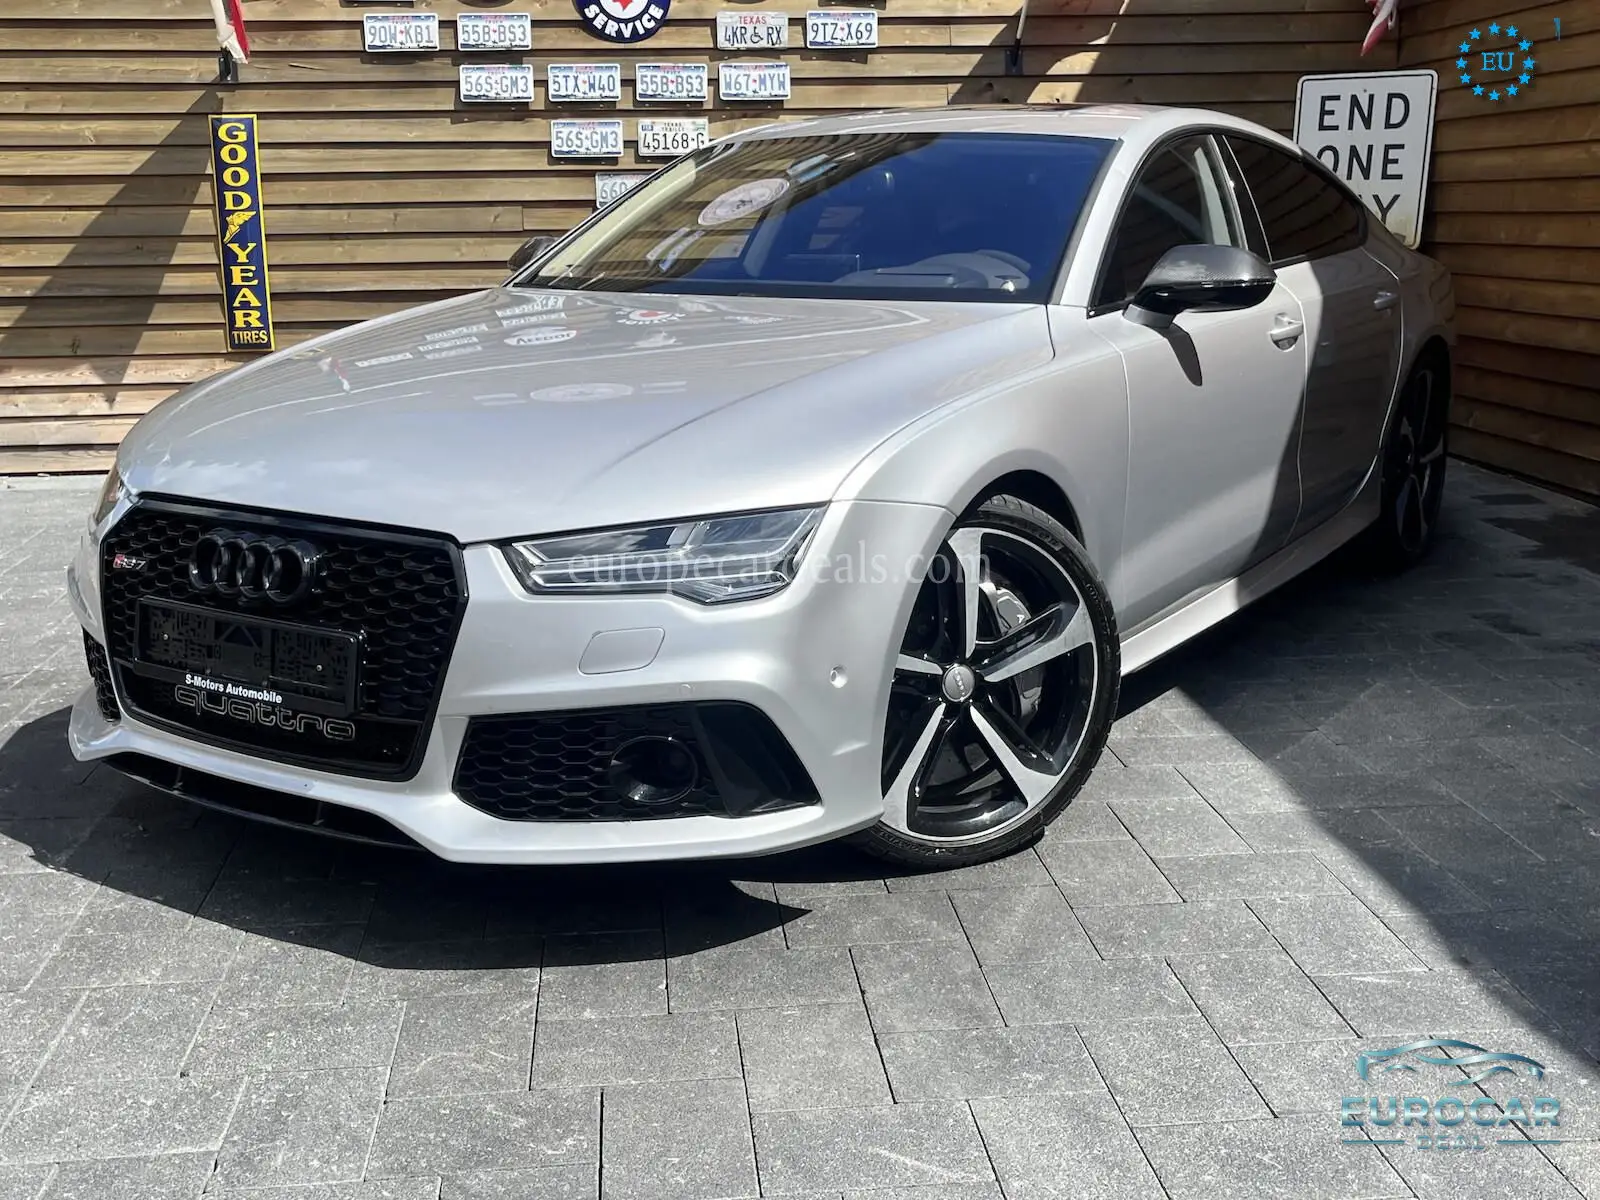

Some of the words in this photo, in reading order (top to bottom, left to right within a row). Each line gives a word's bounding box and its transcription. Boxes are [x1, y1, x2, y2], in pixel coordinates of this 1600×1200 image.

[584, 4, 664, 38] SERVICE
[738, 16, 767, 25] TEXAS
[404, 25, 434, 44] KB1
[462, 24, 491, 43] 55B
[498, 24, 527, 43] BS3
[724, 26, 747, 46] 4KR
[767, 26, 782, 46] RX
[811, 22, 840, 41] 9TZ
[846, 22, 874, 41] X69
[465, 75, 493, 93] 56S
[500, 75, 528, 93] GM3
[552, 74, 581, 93] 5TX
[640, 75, 669, 93] 55B
[675, 75, 704, 93] BS3
[724, 73, 751, 92] W67
[1317, 93, 1411, 131] END
[555, 130, 583, 149] 56S
[590, 130, 619, 149] GM3
[643, 133, 689, 150] 45168
[217, 122, 252, 211] GOOD
[1316, 144, 1405, 180] ONE
[227, 242, 265, 328] YEAR
[232, 330, 268, 344] TIRES
[185, 673, 224, 692] S-Motors
[226, 683, 283, 704] Automobile
[174, 684, 356, 741] quattro
